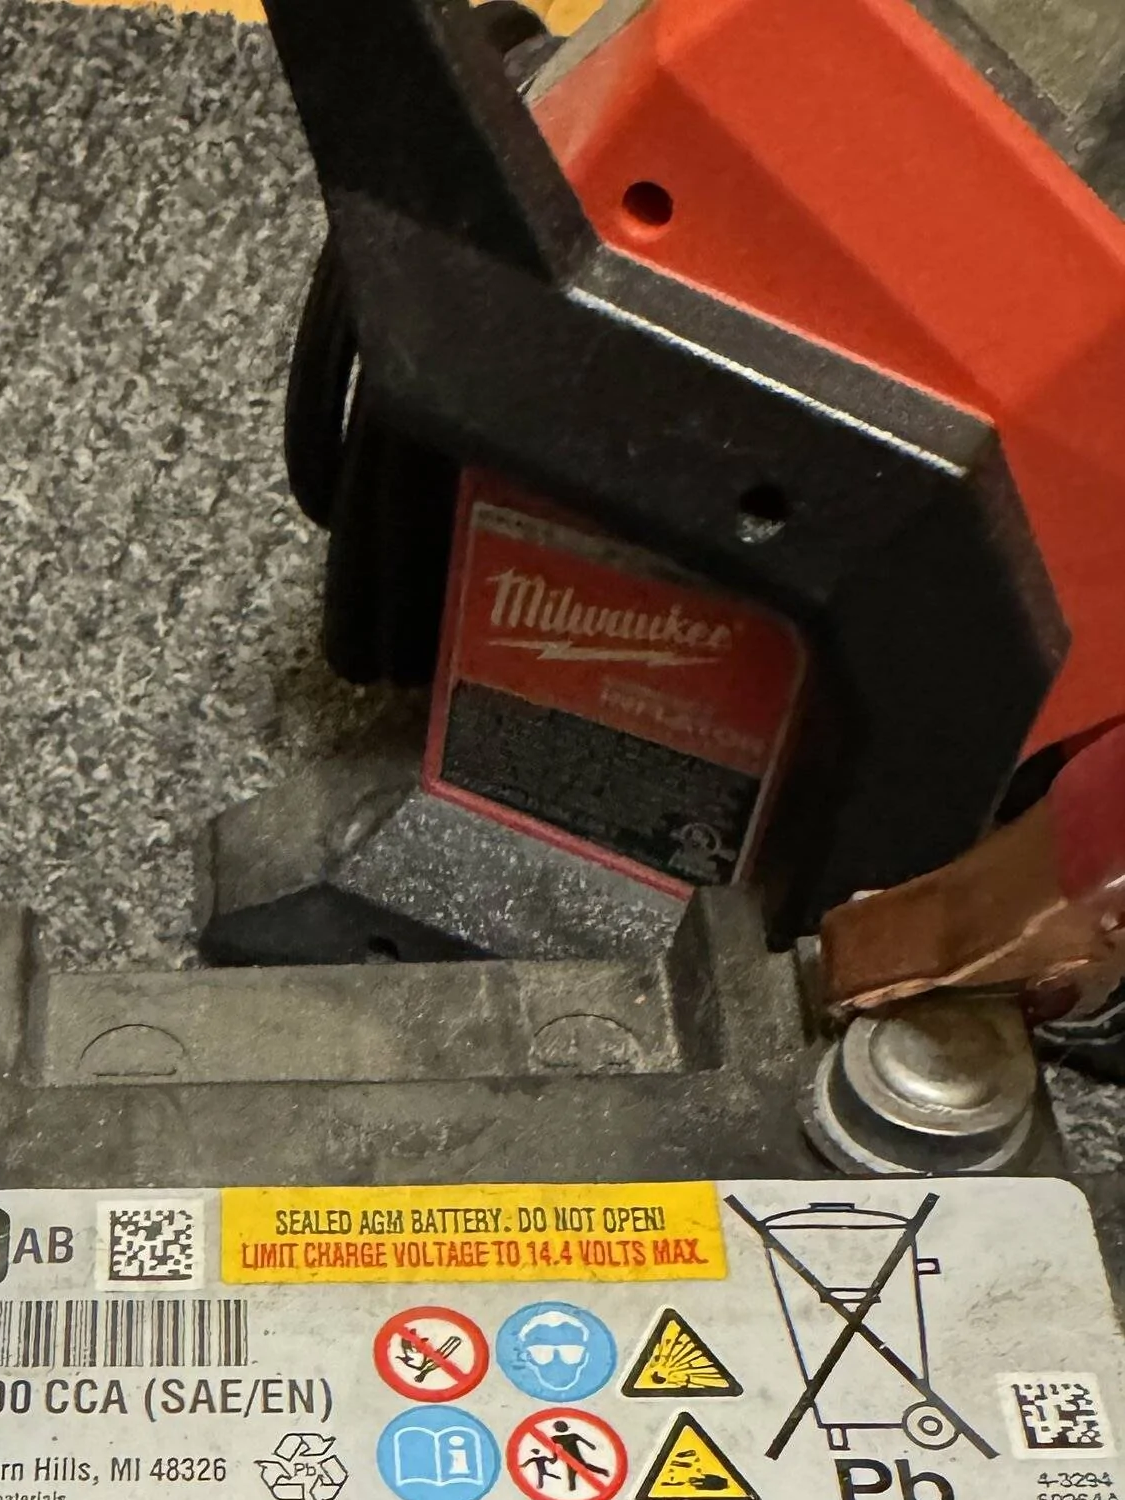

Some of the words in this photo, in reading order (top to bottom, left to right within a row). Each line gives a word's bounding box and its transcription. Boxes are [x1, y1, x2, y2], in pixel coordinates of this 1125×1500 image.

[485, 567, 732, 648] Milwaukee
[276, 1209, 351, 1235] SEALED
[359, 1208, 404, 1235] AGM
[519, 1207, 547, 1232] DO
[556, 1207, 595, 1232] NOT
[603, 1206, 666, 1231] OPEN!
[242, 1242, 298, 1269] LIMIT
[304, 1241, 387, 1268] CHARGE
[393, 1240, 486, 1268] VOLTAGE
[490, 1240, 521, 1266] TO
[527, 1239, 573, 1266] 14.4
[581, 1239, 646, 1265] VOLTS
[45, 1379, 127, 1415] CCA
[144, 1377, 334, 1424] (SAE/EN)
[34, 1456, 99, 1486] Hills,
[111, 1456, 141, 1482] MI
[148, 1457, 228, 1482] 48326
